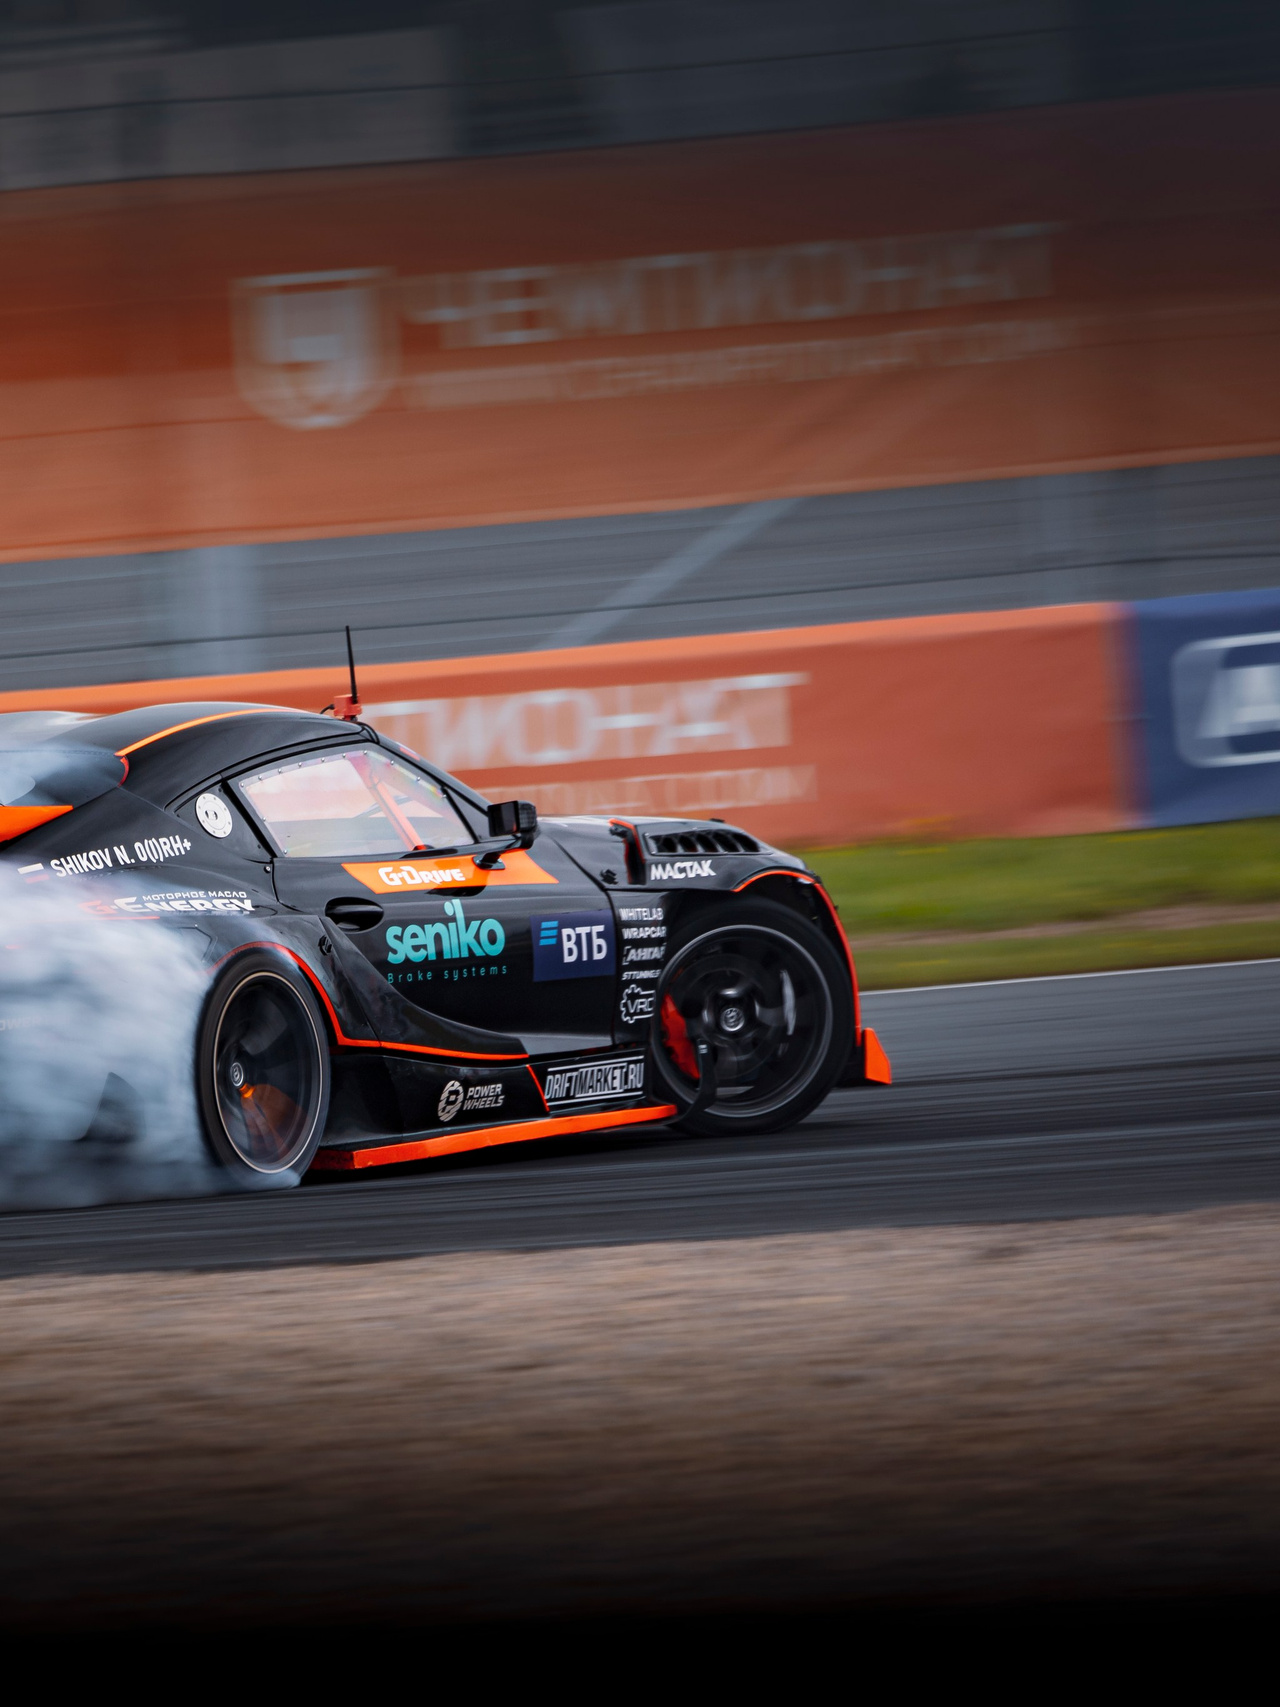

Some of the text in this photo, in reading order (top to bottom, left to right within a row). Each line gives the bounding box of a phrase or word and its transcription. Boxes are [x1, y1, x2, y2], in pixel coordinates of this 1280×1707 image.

[50, 848, 113, 878] SHIKOV
[113, 845, 136, 866] N.
[619, 907, 664, 921] WHITELAB
[385, 898, 506, 964] seniko
[387, 964, 507, 984] Brake systems
[466, 1083, 503, 1099] POWER
[545, 1062, 645, 1100] DRIFTMARKET.RU
[463, 1095, 505, 1111] WHEELS
